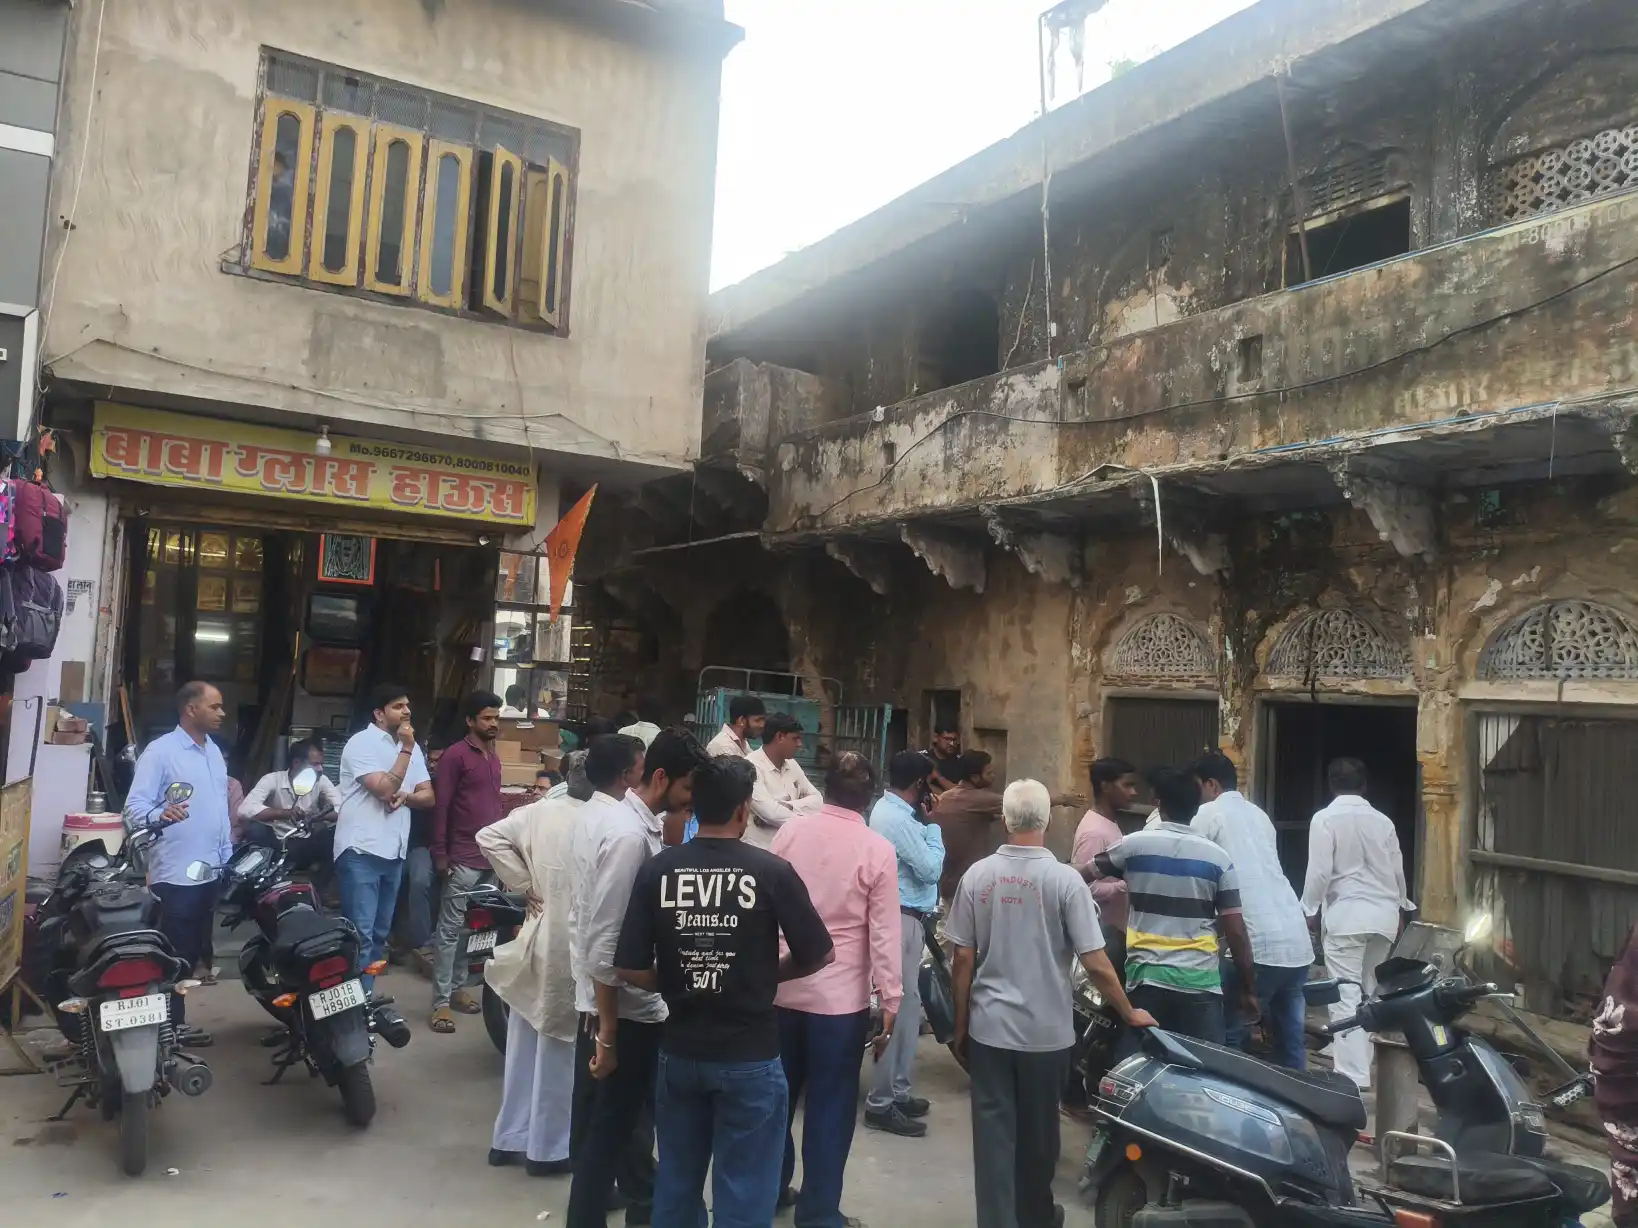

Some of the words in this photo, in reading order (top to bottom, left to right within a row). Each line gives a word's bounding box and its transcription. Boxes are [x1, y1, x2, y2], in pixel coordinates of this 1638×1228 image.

[103, 425, 231, 484] बाबा
[234, 445, 377, 500] ग्लास
[389, 464, 530, 518] हाऊस
[660, 873, 757, 909] LEVI'S
[1001, 896, 1023, 905] KOTA
[675, 910, 738, 930] Jeans.co
[692, 970, 718, 990] 501
[320, 983, 354, 1003] RJ01B
[323, 995, 357, 1016] H8908
